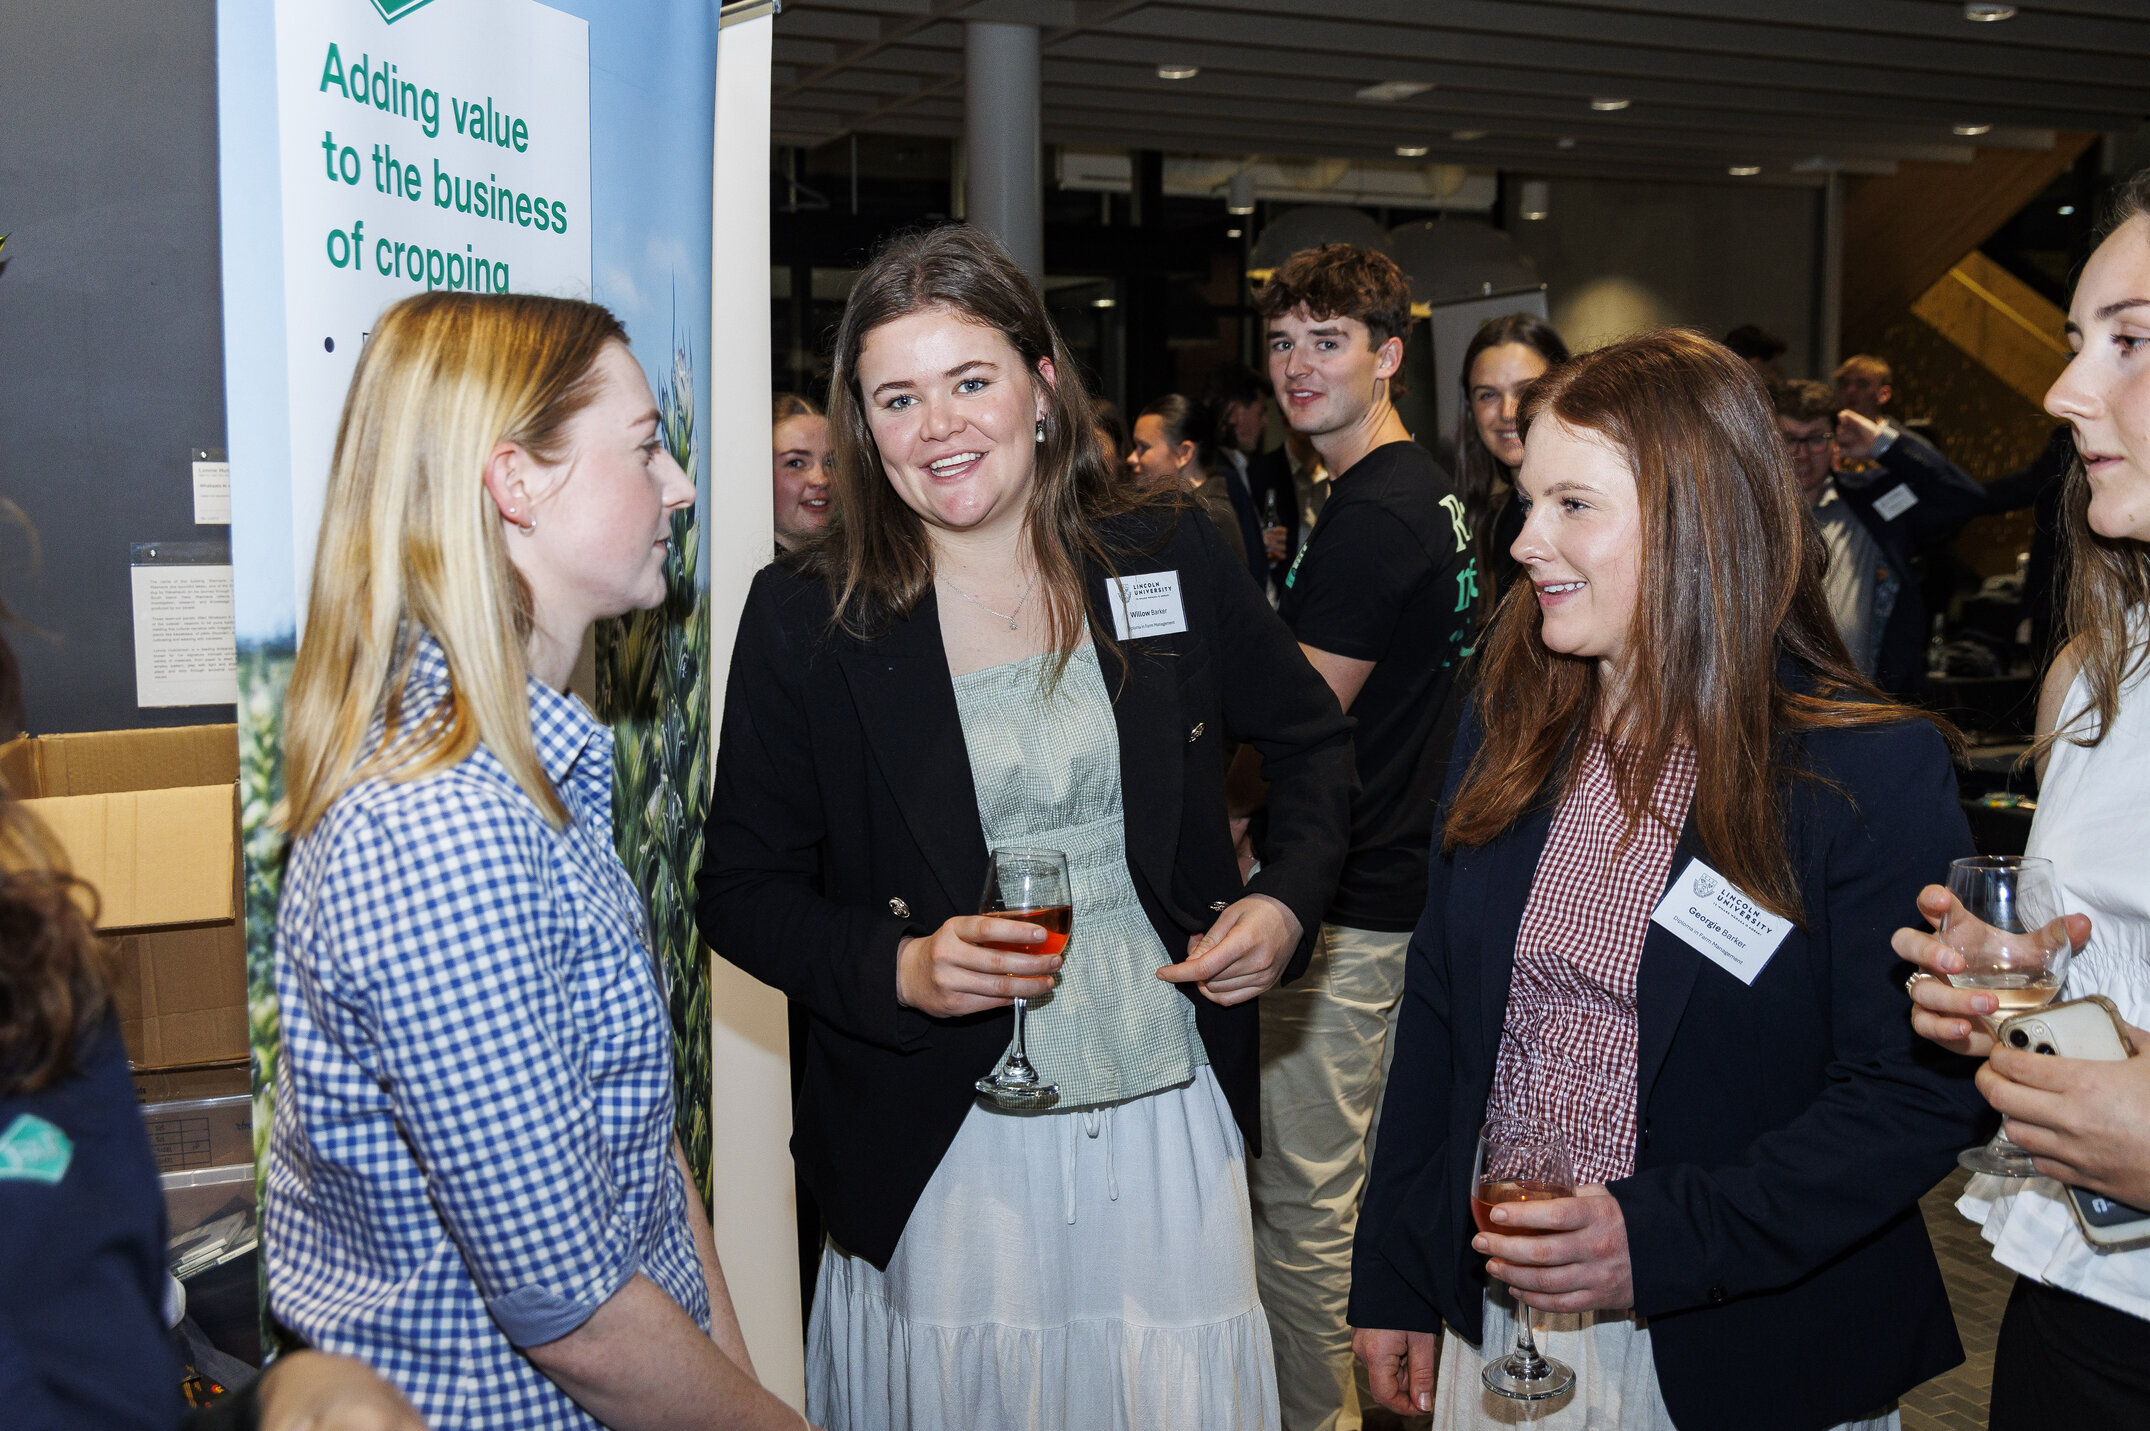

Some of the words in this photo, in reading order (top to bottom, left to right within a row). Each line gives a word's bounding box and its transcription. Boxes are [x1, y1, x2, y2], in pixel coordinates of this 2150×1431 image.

[319, 42, 440, 139] Adding
[451, 96, 529, 154] value
[321, 130, 361, 186] to
[372, 143, 422, 202] the
[433, 158, 568, 235] business
[327, 220, 364, 271] of
[376, 238, 510, 294] cropping
[1133, 582, 1160, 590] LINCOLN
[1134, 586, 1172, 596] UNIVERSITY
[1130, 610, 1151, 618] Willow
[1151, 608, 1167, 616] Barker
[1716, 894, 1773, 934] UNIVERSITY
[1720, 888, 1760, 918] LINCOLN
[1673, 915, 1694, 933] Diploma
[1699, 932, 1713, 945] Farm
[1712, 941, 1744, 965] Management
[1688, 906, 1722, 933] Georgie
[1721, 928, 1747, 950] Barker
